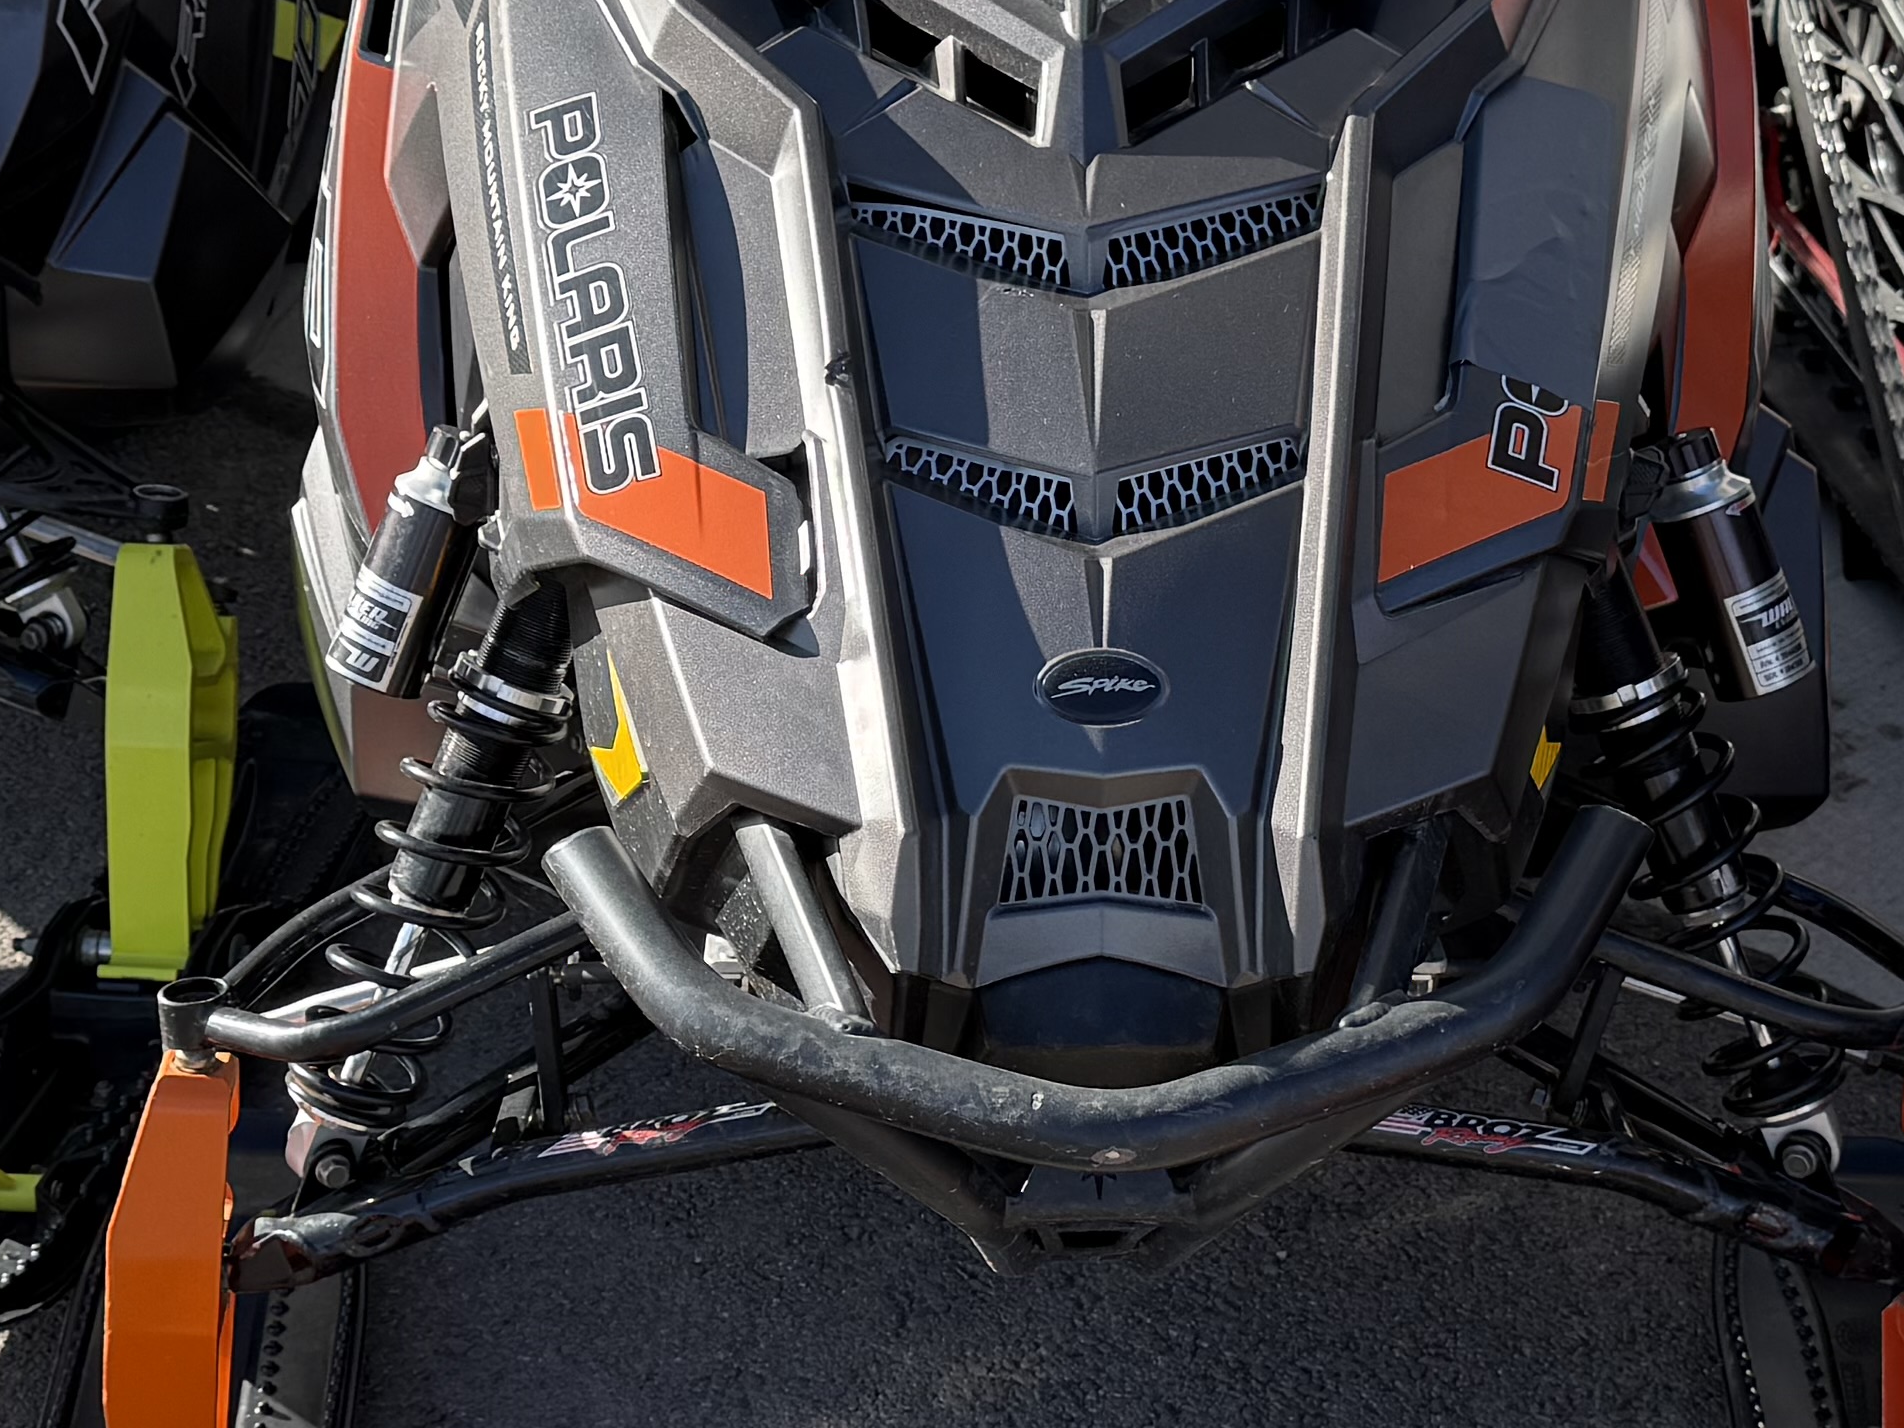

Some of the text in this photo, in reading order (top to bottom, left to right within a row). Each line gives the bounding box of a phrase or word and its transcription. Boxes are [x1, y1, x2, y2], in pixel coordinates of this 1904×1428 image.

[475, 20, 522, 352] ROCKY MOUNTAIN KING
[528, 90, 661, 496] POLARIS
